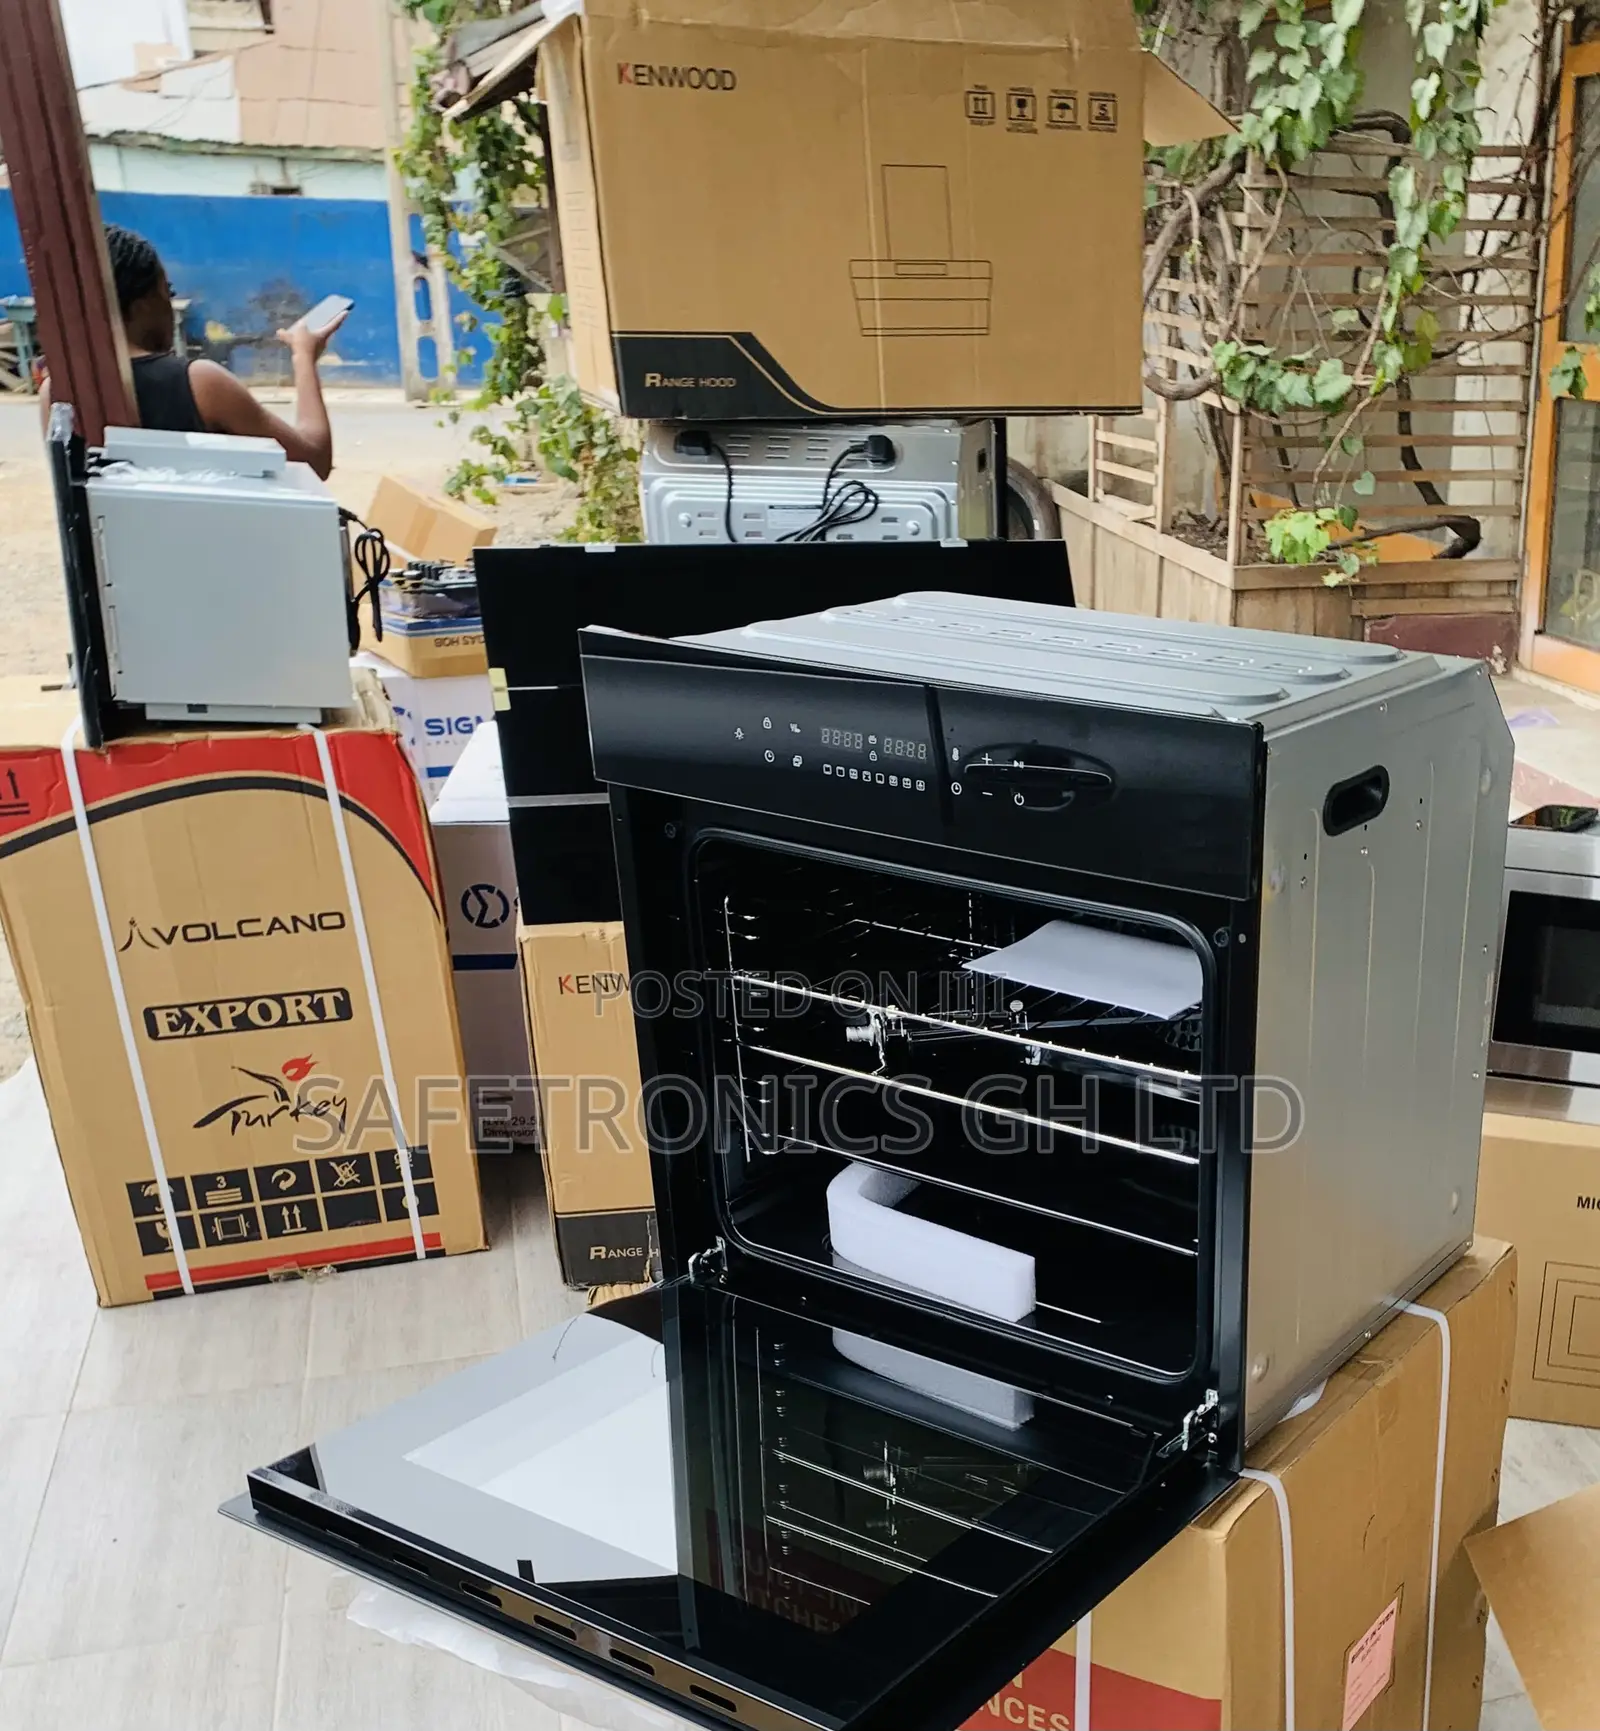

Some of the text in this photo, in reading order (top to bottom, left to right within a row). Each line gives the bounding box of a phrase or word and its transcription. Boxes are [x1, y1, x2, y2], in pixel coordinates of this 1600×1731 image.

[617, 62, 737, 91] KENWOOD
[698, 377, 737, 388] HOOD
[424, 715, 497, 736] SIG
[151, 911, 346, 946] VOLCANO
[151, 991, 344, 1038] EXPORT
[215, 1175, 227, 1189] 3
[589, 1246, 644, 1260] RANGE
